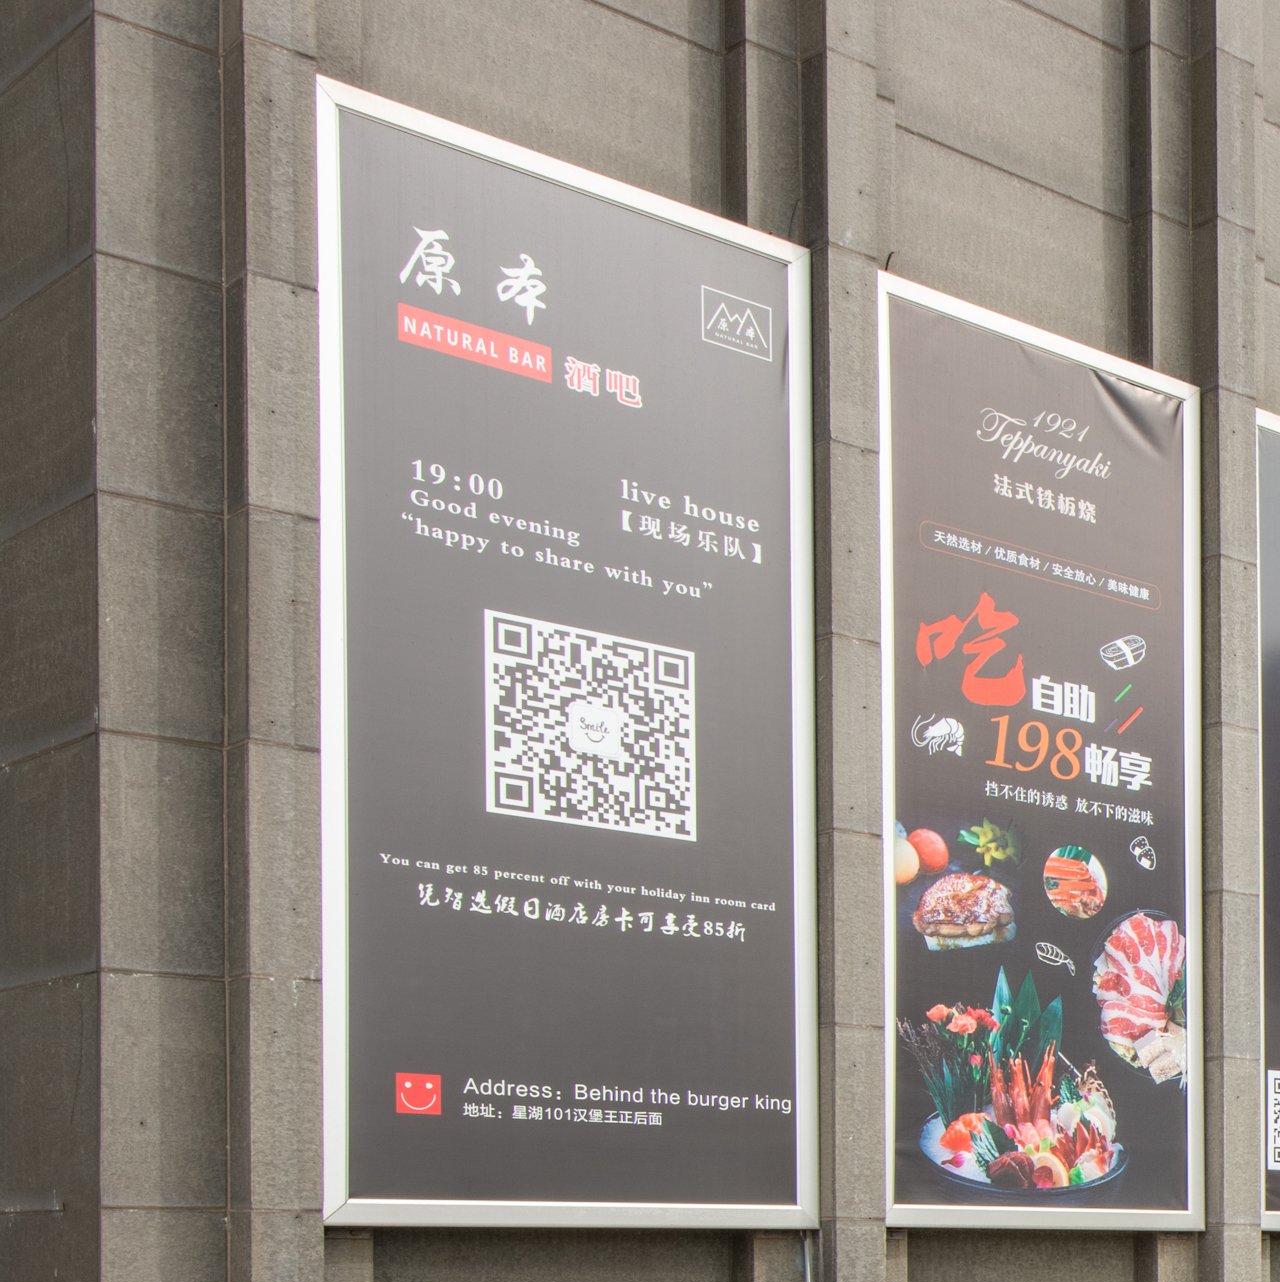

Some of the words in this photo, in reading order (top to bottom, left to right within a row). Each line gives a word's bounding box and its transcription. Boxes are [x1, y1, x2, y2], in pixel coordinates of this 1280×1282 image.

[400, 226, 547, 325] 原本
[403, 315, 499, 359] NATURAL
[508, 346, 547, 373] BAR
[714, 331, 744, 345] NATURAL
[745, 341, 759, 350] BAR
[564, 356, 643, 408] 酒吧
[976, 407, 1113, 480] Teppanyaki
[1032, 409, 1090, 442] 1921
[410, 458, 503, 500] 19:00
[993, 473, 1097, 524] 法式铁板烧
[410, 489, 478, 519] Good
[488, 507, 581, 547] evening
[620, 478, 672, 511] live
[684, 495, 760, 533] house
[501, 539, 525, 560] to
[535, 545, 595, 575] share
[604, 562, 653, 588] with
[916, 592, 1026, 706] 吃
[1032, 675, 1096, 723] 自助
[580, 716, 610, 734] Smile
[985, 715, 1083, 780] 198
[1084, 743, 1153, 791] 畅享
[985, 780, 1069, 811] 挡不住的诱惑
[1075, 797, 1154, 826] 放不下的滋味
[379, 853, 410, 867] You
[416, 859, 440, 870] can
[446, 862, 468, 875] get
[473, 865, 489, 877] 85
[494, 868, 545, 885] percent
[550, 875, 571, 887] off
[573, 877, 603, 891] with
[607, 883, 637, 897] your
[641, 885, 687, 903] holiday
[690, 891, 711, 903] inn
[714, 896, 747, 909] room
[750, 900, 776, 912] card
[417, 882, 746, 942] 凭智选假日酒店房卡可享受85折
[574, 1083, 644, 1104] Behind
[650, 1088, 682, 1106] the
[687, 1091, 749, 1114] burger
[754, 1093, 792, 1114] king
